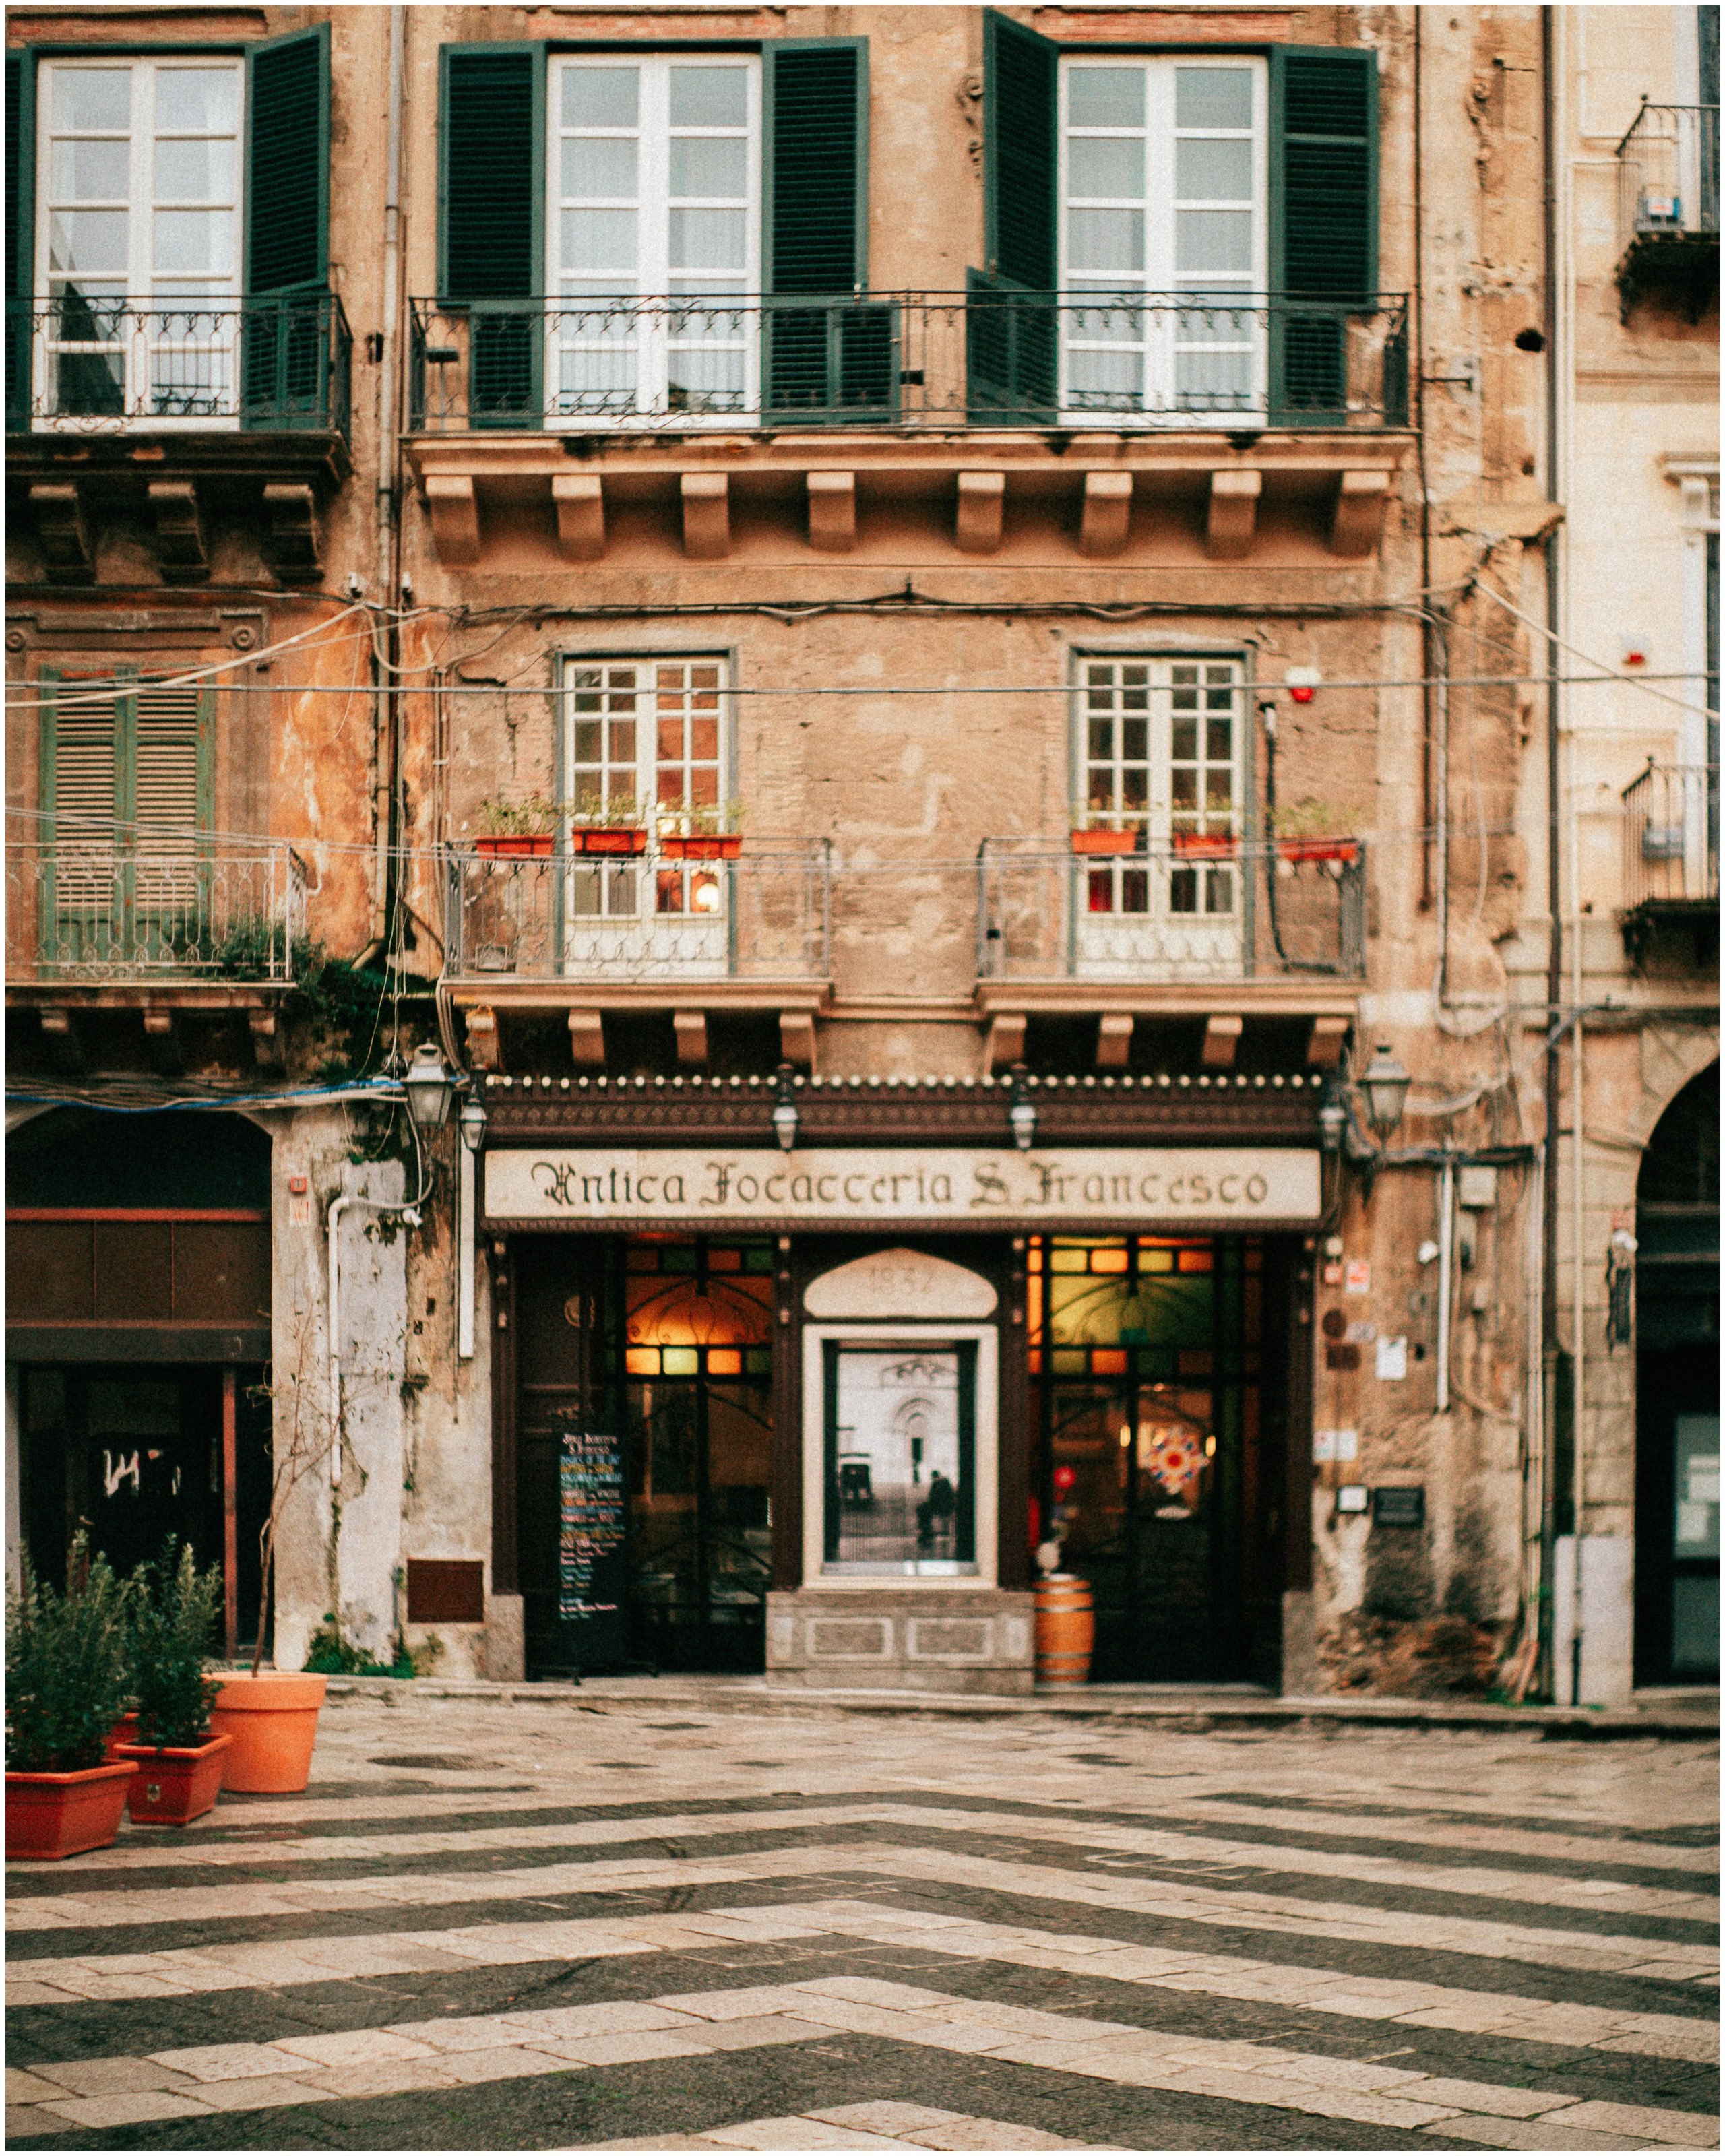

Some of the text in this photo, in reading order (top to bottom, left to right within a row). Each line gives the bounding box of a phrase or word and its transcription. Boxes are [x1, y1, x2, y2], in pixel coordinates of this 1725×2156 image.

[530, 1161, 687, 1206] Antica
[699, 1161, 953, 1206] Focacceria
[1022, 1161, 1269, 1207] Francesco
